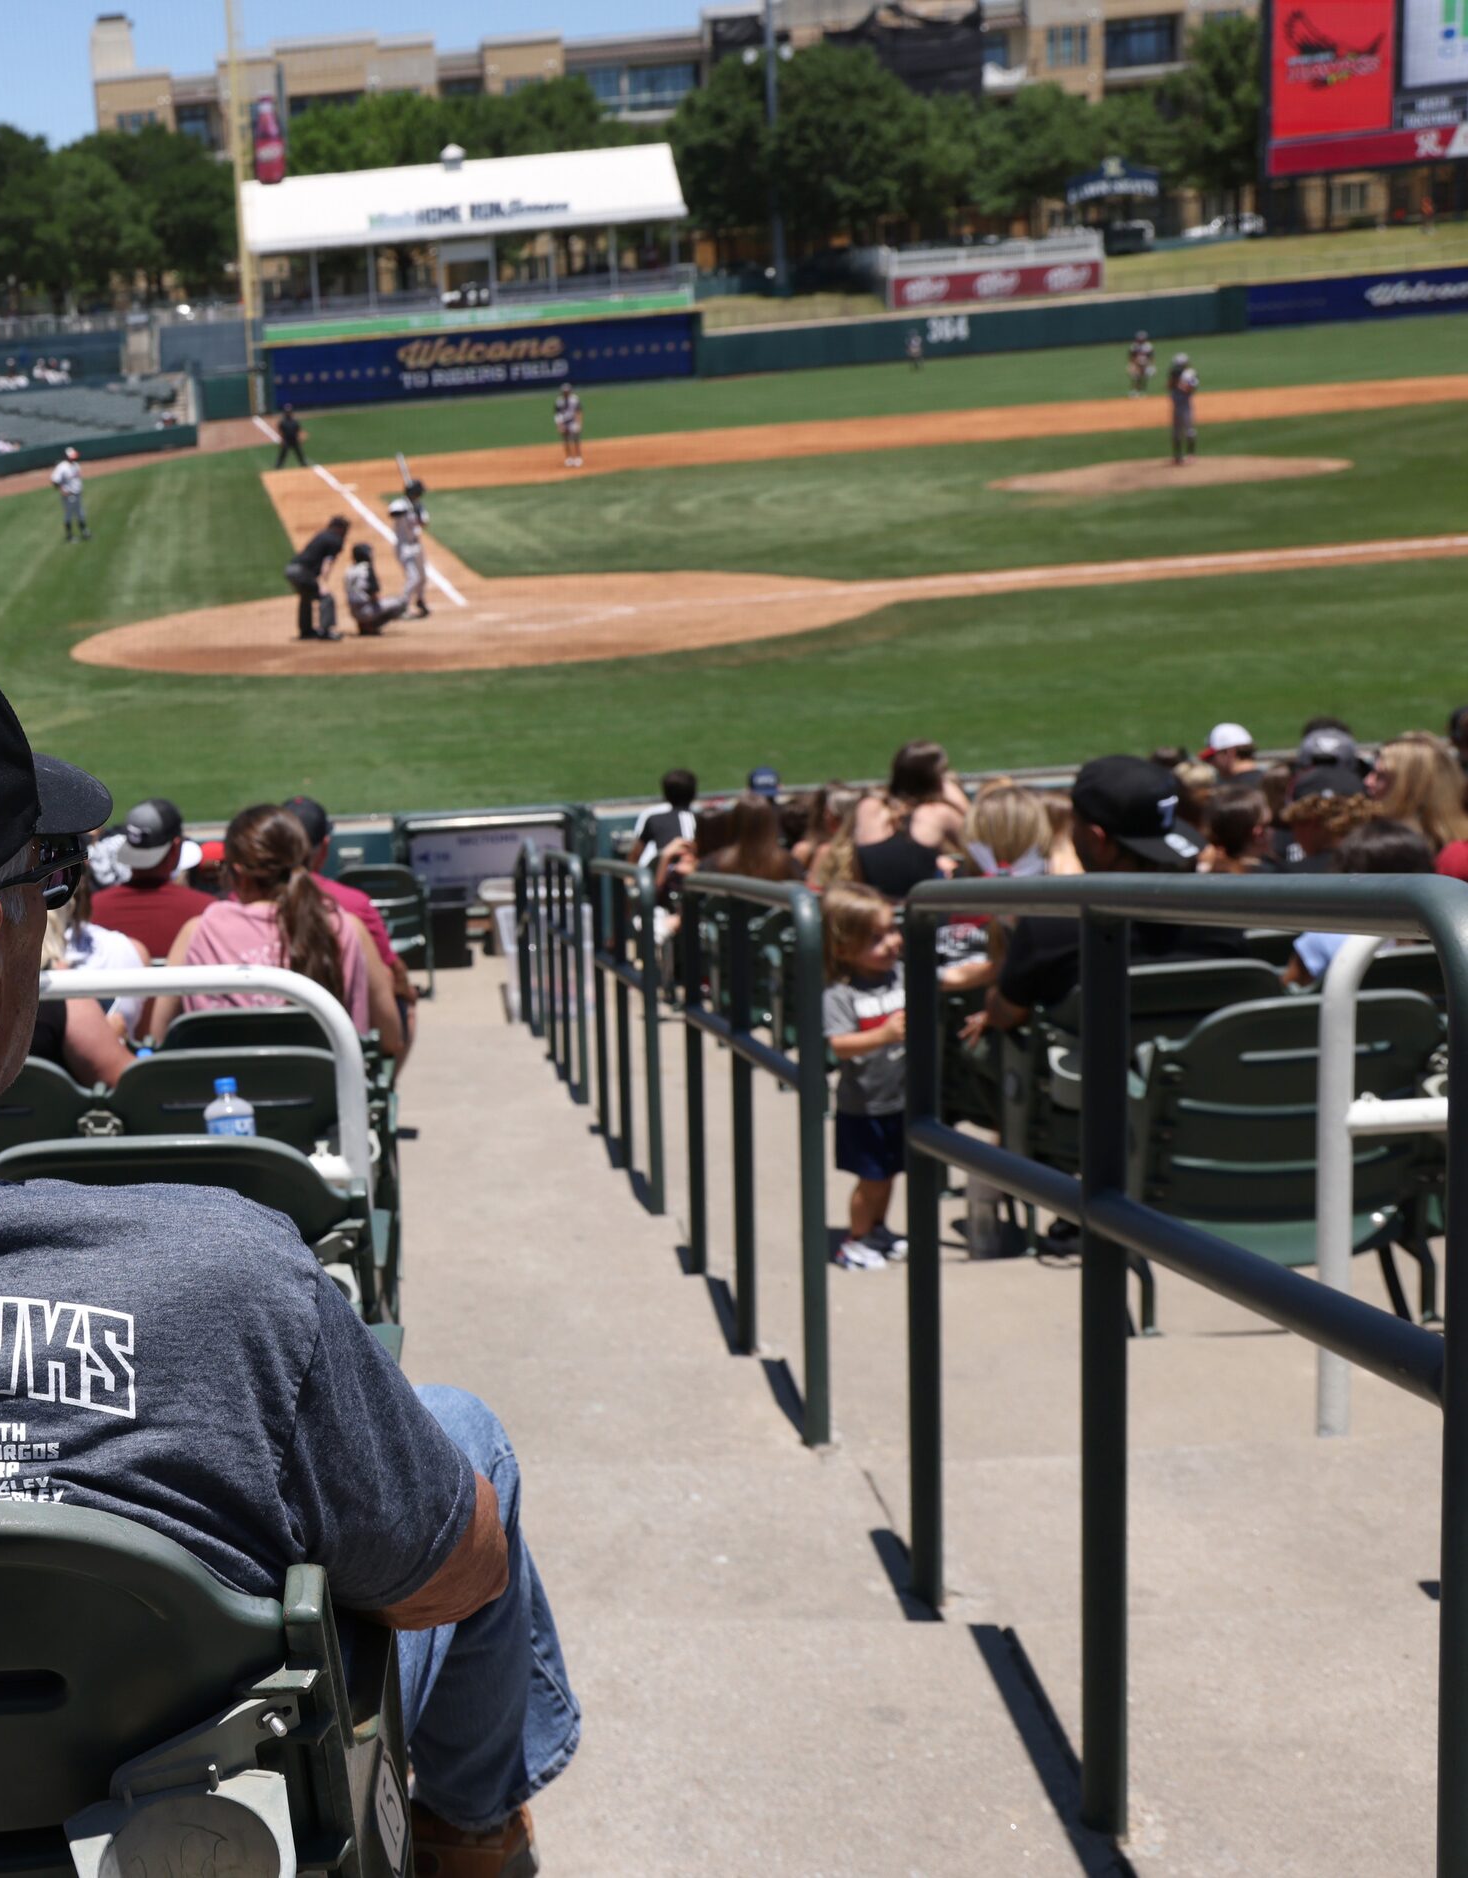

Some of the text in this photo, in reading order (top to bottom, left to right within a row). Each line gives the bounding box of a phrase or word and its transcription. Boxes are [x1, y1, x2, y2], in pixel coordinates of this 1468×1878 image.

[416, 205, 461, 226] HOME
[926, 315, 970, 343] 364
[398, 335, 564, 369] Welcome
[401, 358, 569, 389] TO RIDERS FIELD
